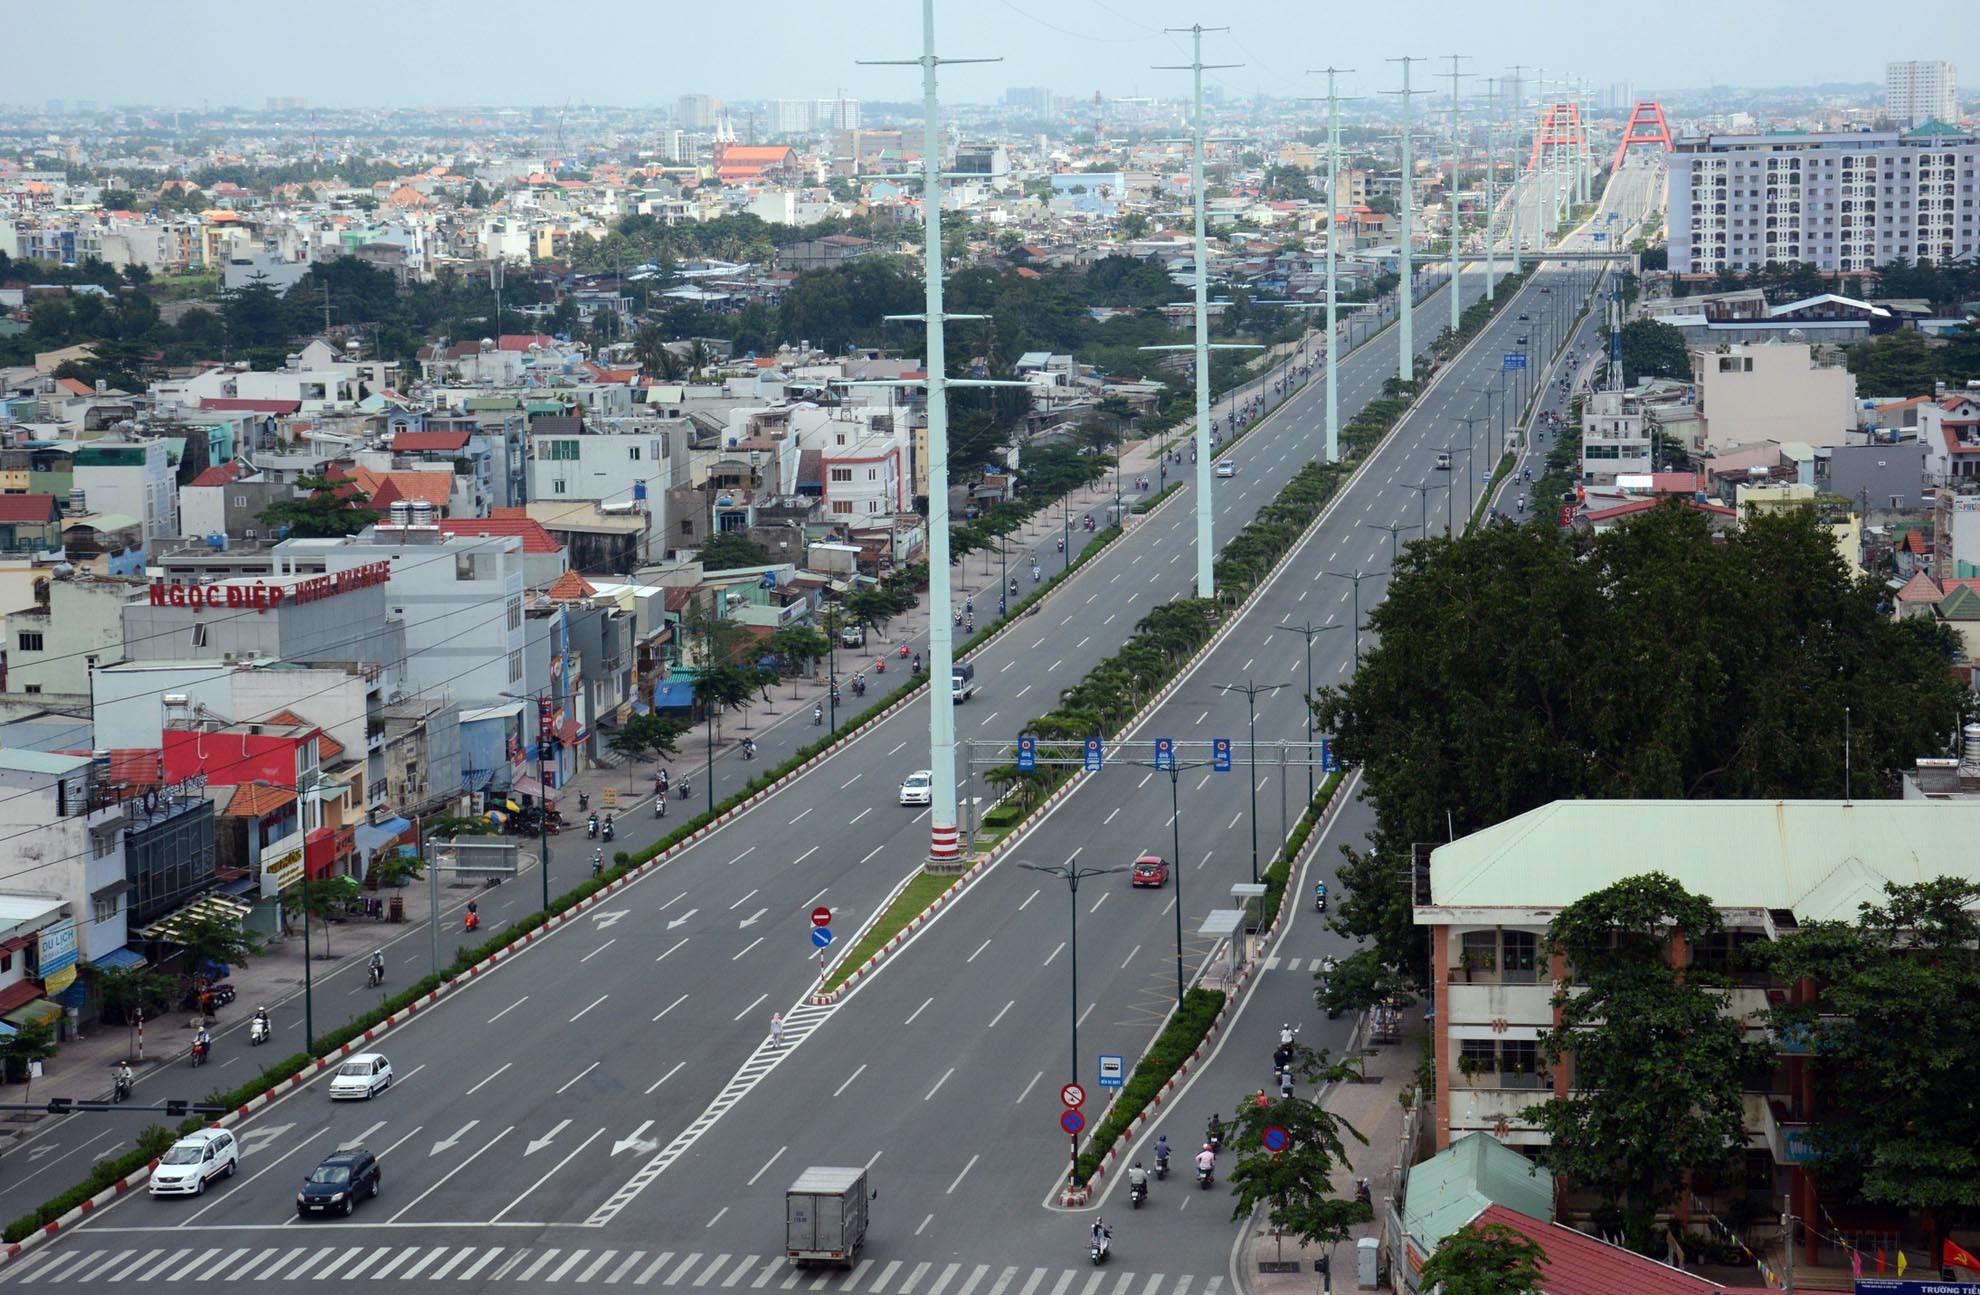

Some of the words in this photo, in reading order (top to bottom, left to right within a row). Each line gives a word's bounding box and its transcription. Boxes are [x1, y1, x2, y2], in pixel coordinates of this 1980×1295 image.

[295, 575, 334, 606] HOTEL
[336, 560, 390, 594] MASSAGE
[150, 583, 220, 613] NGỌC
[227, 580, 284, 615] ĐIỆP
[42, 939, 54, 952] DU
[1921, 1285, 1960, 1295] TRƯỜNG
